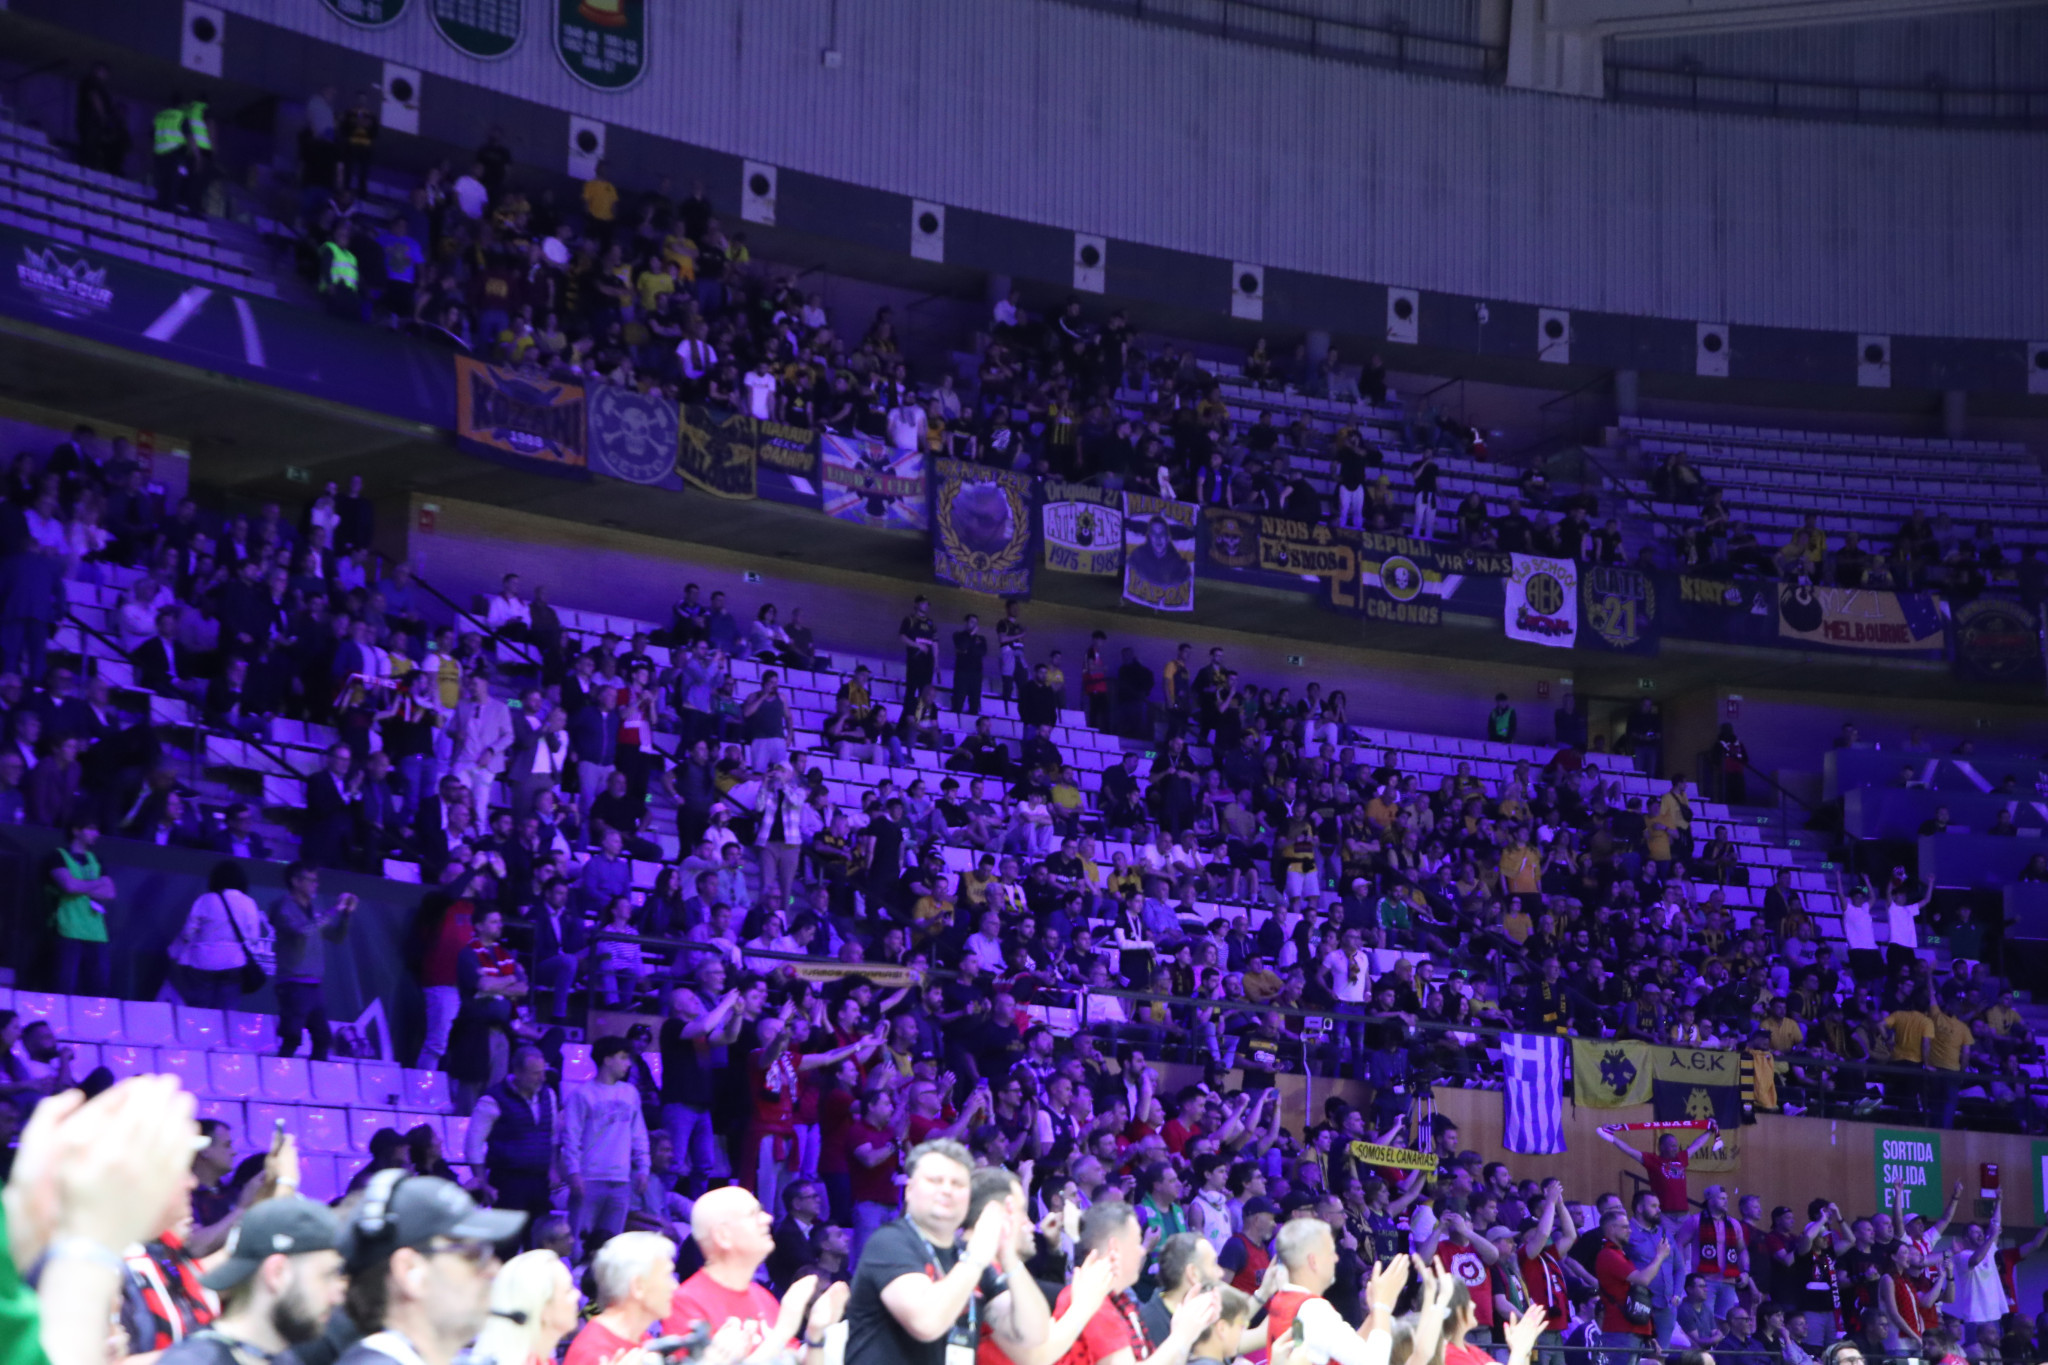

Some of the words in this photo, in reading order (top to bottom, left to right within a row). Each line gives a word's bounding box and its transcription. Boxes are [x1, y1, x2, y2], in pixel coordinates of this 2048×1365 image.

[1260, 514, 1309, 541] NEOS
[1049, 544, 1079, 571] 1975
[1367, 597, 1439, 625] COLONOS
[1604, 593, 1636, 639] 21
[1823, 620, 1909, 644] MELBOURNE
[1757, 816, 1769, 824] 27
[1358, 1144, 1385, 1162] SOMOS
[1386, 1148, 1395, 1163] EL
[1396, 1150, 1434, 1167] CANARIAS
[1882, 1139, 1934, 1163] SORTIDA
[1883, 1163, 1927, 1186] SALIDA
[1884, 1187, 1911, 1209] EIT
